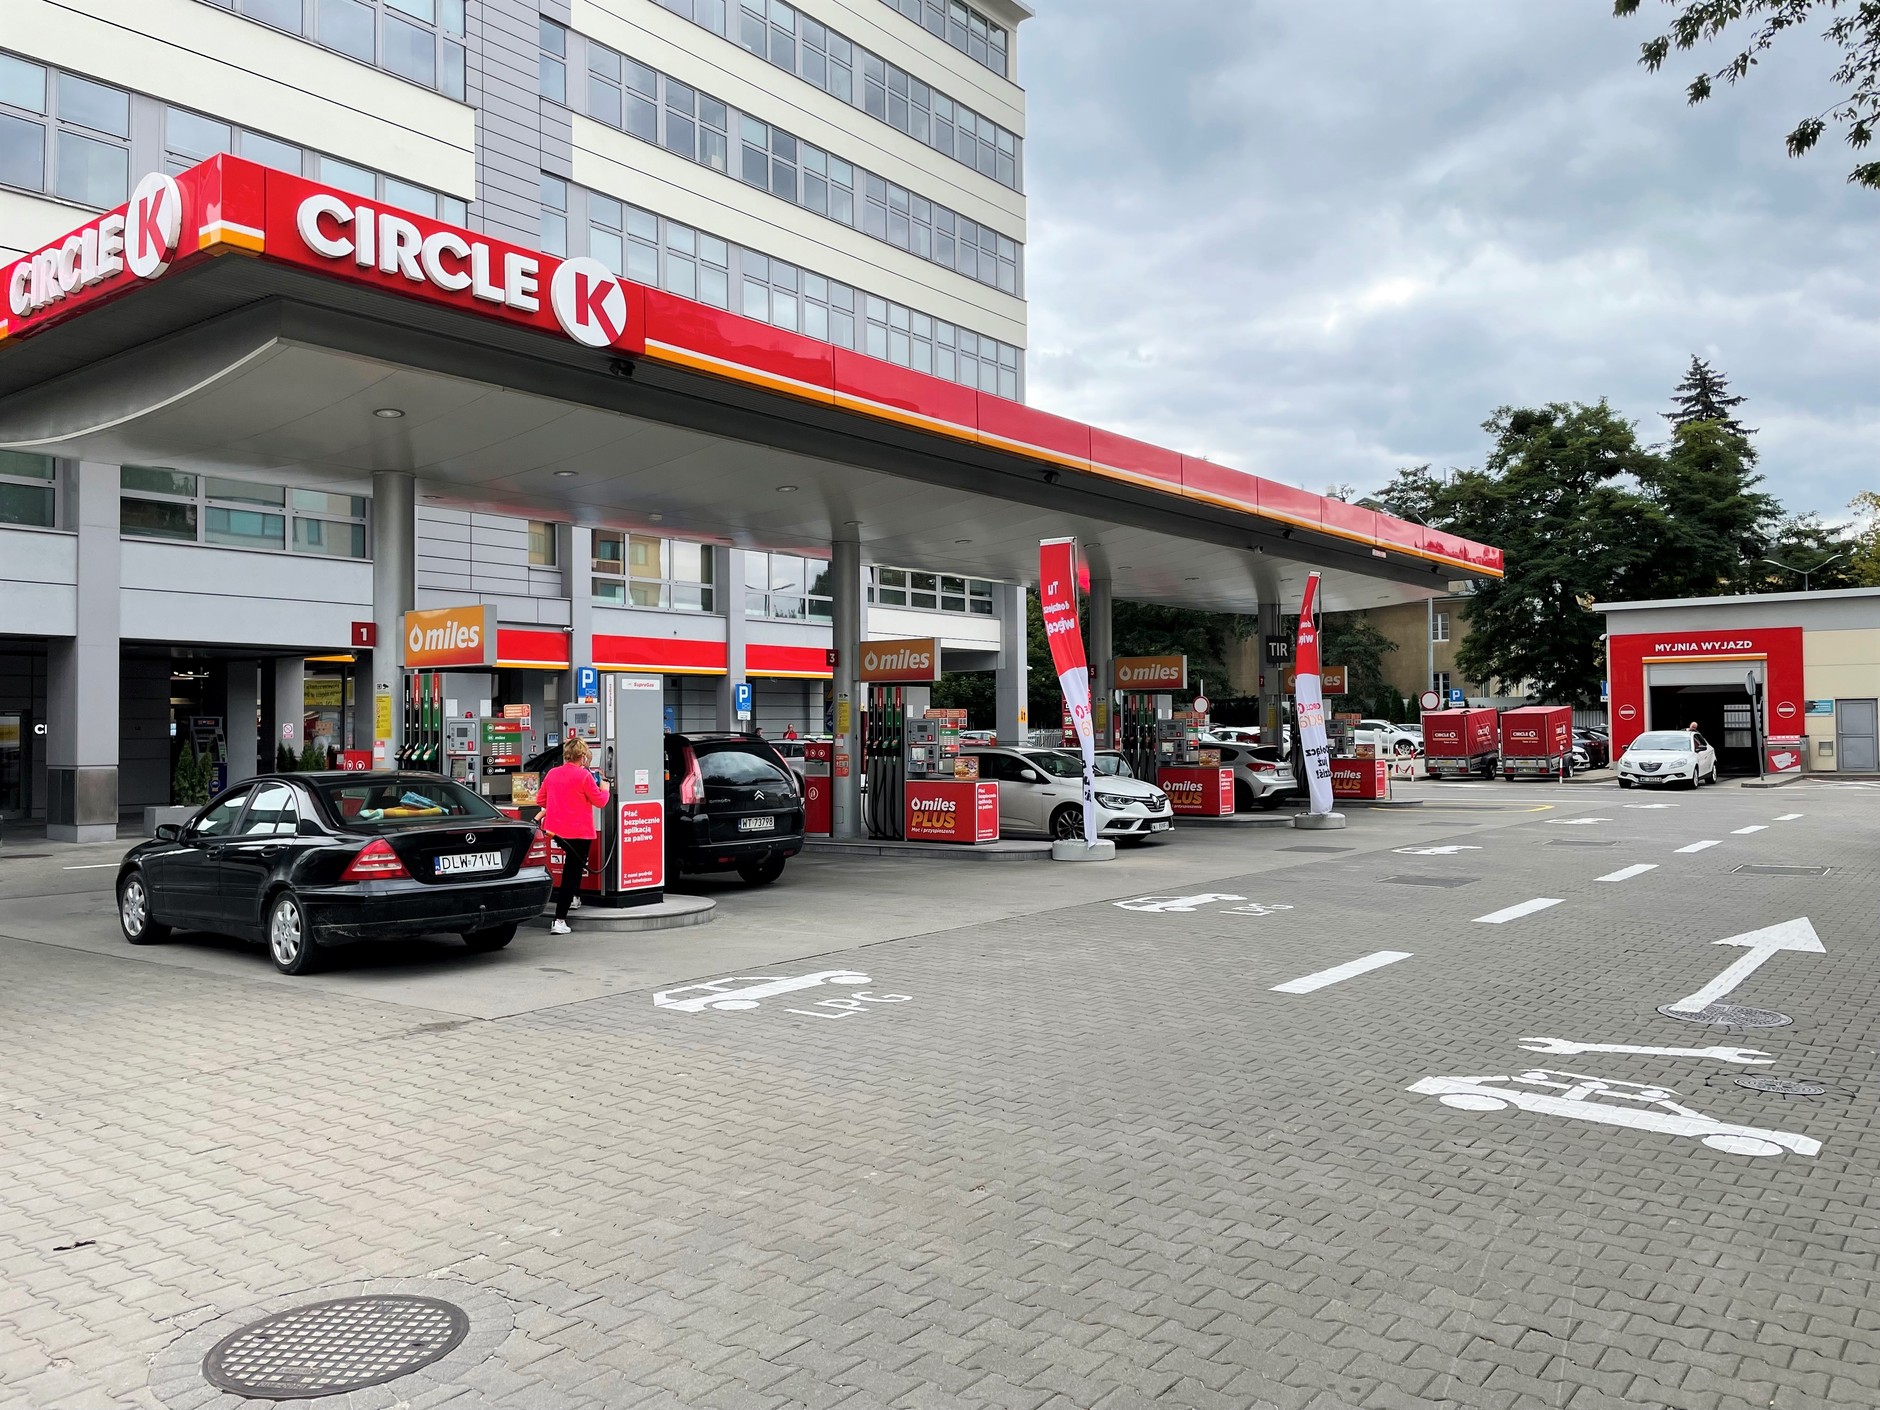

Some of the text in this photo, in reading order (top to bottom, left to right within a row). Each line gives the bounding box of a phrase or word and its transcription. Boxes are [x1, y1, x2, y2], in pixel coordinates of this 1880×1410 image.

[297, 194, 541, 313] CIRCLE
[9, 214, 124, 317] CIRCLE
[360, 627, 368, 641] 1
[424, 620, 480, 651] miles
[1268, 642, 1288, 657] TIR
[1654, 640, 1753, 652] MYJNIA WYJAZD
[829, 653, 835, 663] 3
[879, 648, 930, 670] miles
[582, 669, 594, 689] P
[1090, 668, 1095, 676] 5
[1132, 663, 1179, 680] miles
[739, 686, 749, 703] P
[1452, 690, 1461, 701] P
[1333, 770, 1362, 779] miles
[1171, 780, 1203, 792] miles
[921, 797, 957, 812] miles
[623, 809, 638, 818] Płać
[911, 811, 957, 829] PLUS
[623, 817, 661, 827] bezpiecznie
[623, 826, 652, 836] aplikacją
[632, 834, 654, 844] paliwo
[442, 853, 500, 870] DLW 71VL
[1219, 902, 1294, 917] LPG
[783, 991, 913, 1019] LPG
